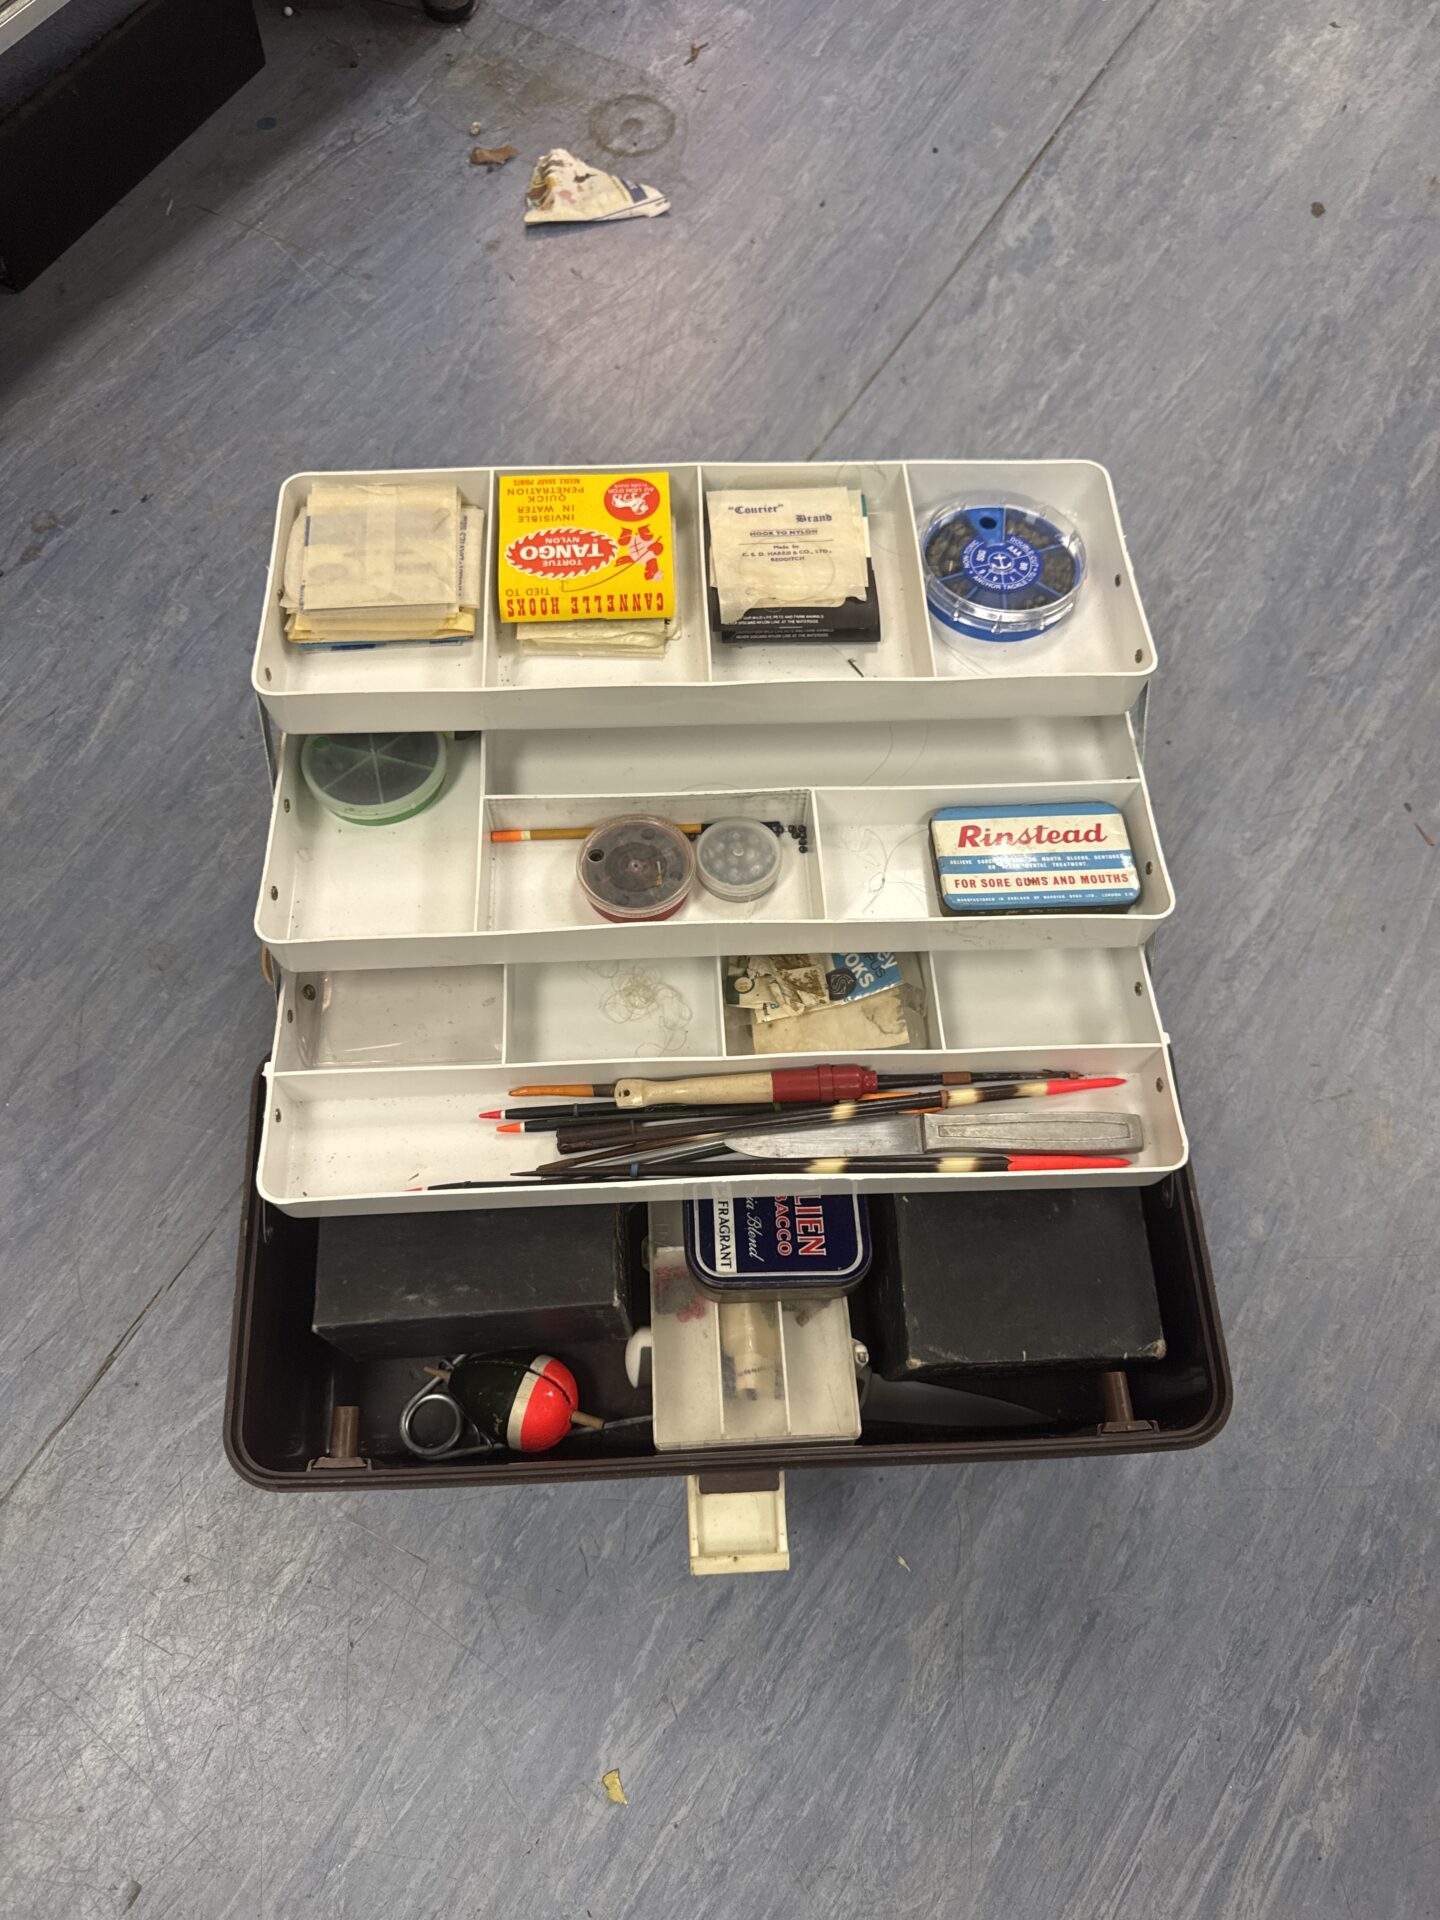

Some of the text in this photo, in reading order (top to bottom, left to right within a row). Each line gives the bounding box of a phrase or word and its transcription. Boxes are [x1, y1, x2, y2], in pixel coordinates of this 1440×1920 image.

[513, 479, 534, 487] POINTS
[536, 478, 557, 486] SHARP
[506, 486, 584, 496] PENETRATION
[528, 494, 567, 503] QUICK
[517, 504, 575, 513] IN WATER
[518, 513, 575, 523] INVISIBLE
[795, 513, 833, 523] Brand
[545, 536, 580, 544] NYLON
[519, 543, 604, 561] TANGO
[542, 559, 583, 567] TORTUE
[505, 587, 551, 597] TIED TO
[506, 592, 664, 618] CANNELLE HOOKS
[957, 823, 1108, 849] Rinstead
[954, 873, 1129, 889] FOR SORE GUMS AND MOUTHS
[842, 953, 875, 988] OKS
[717, 1200, 732, 1269] FRAGRANT
[746, 1211, 765, 1262] Blend
